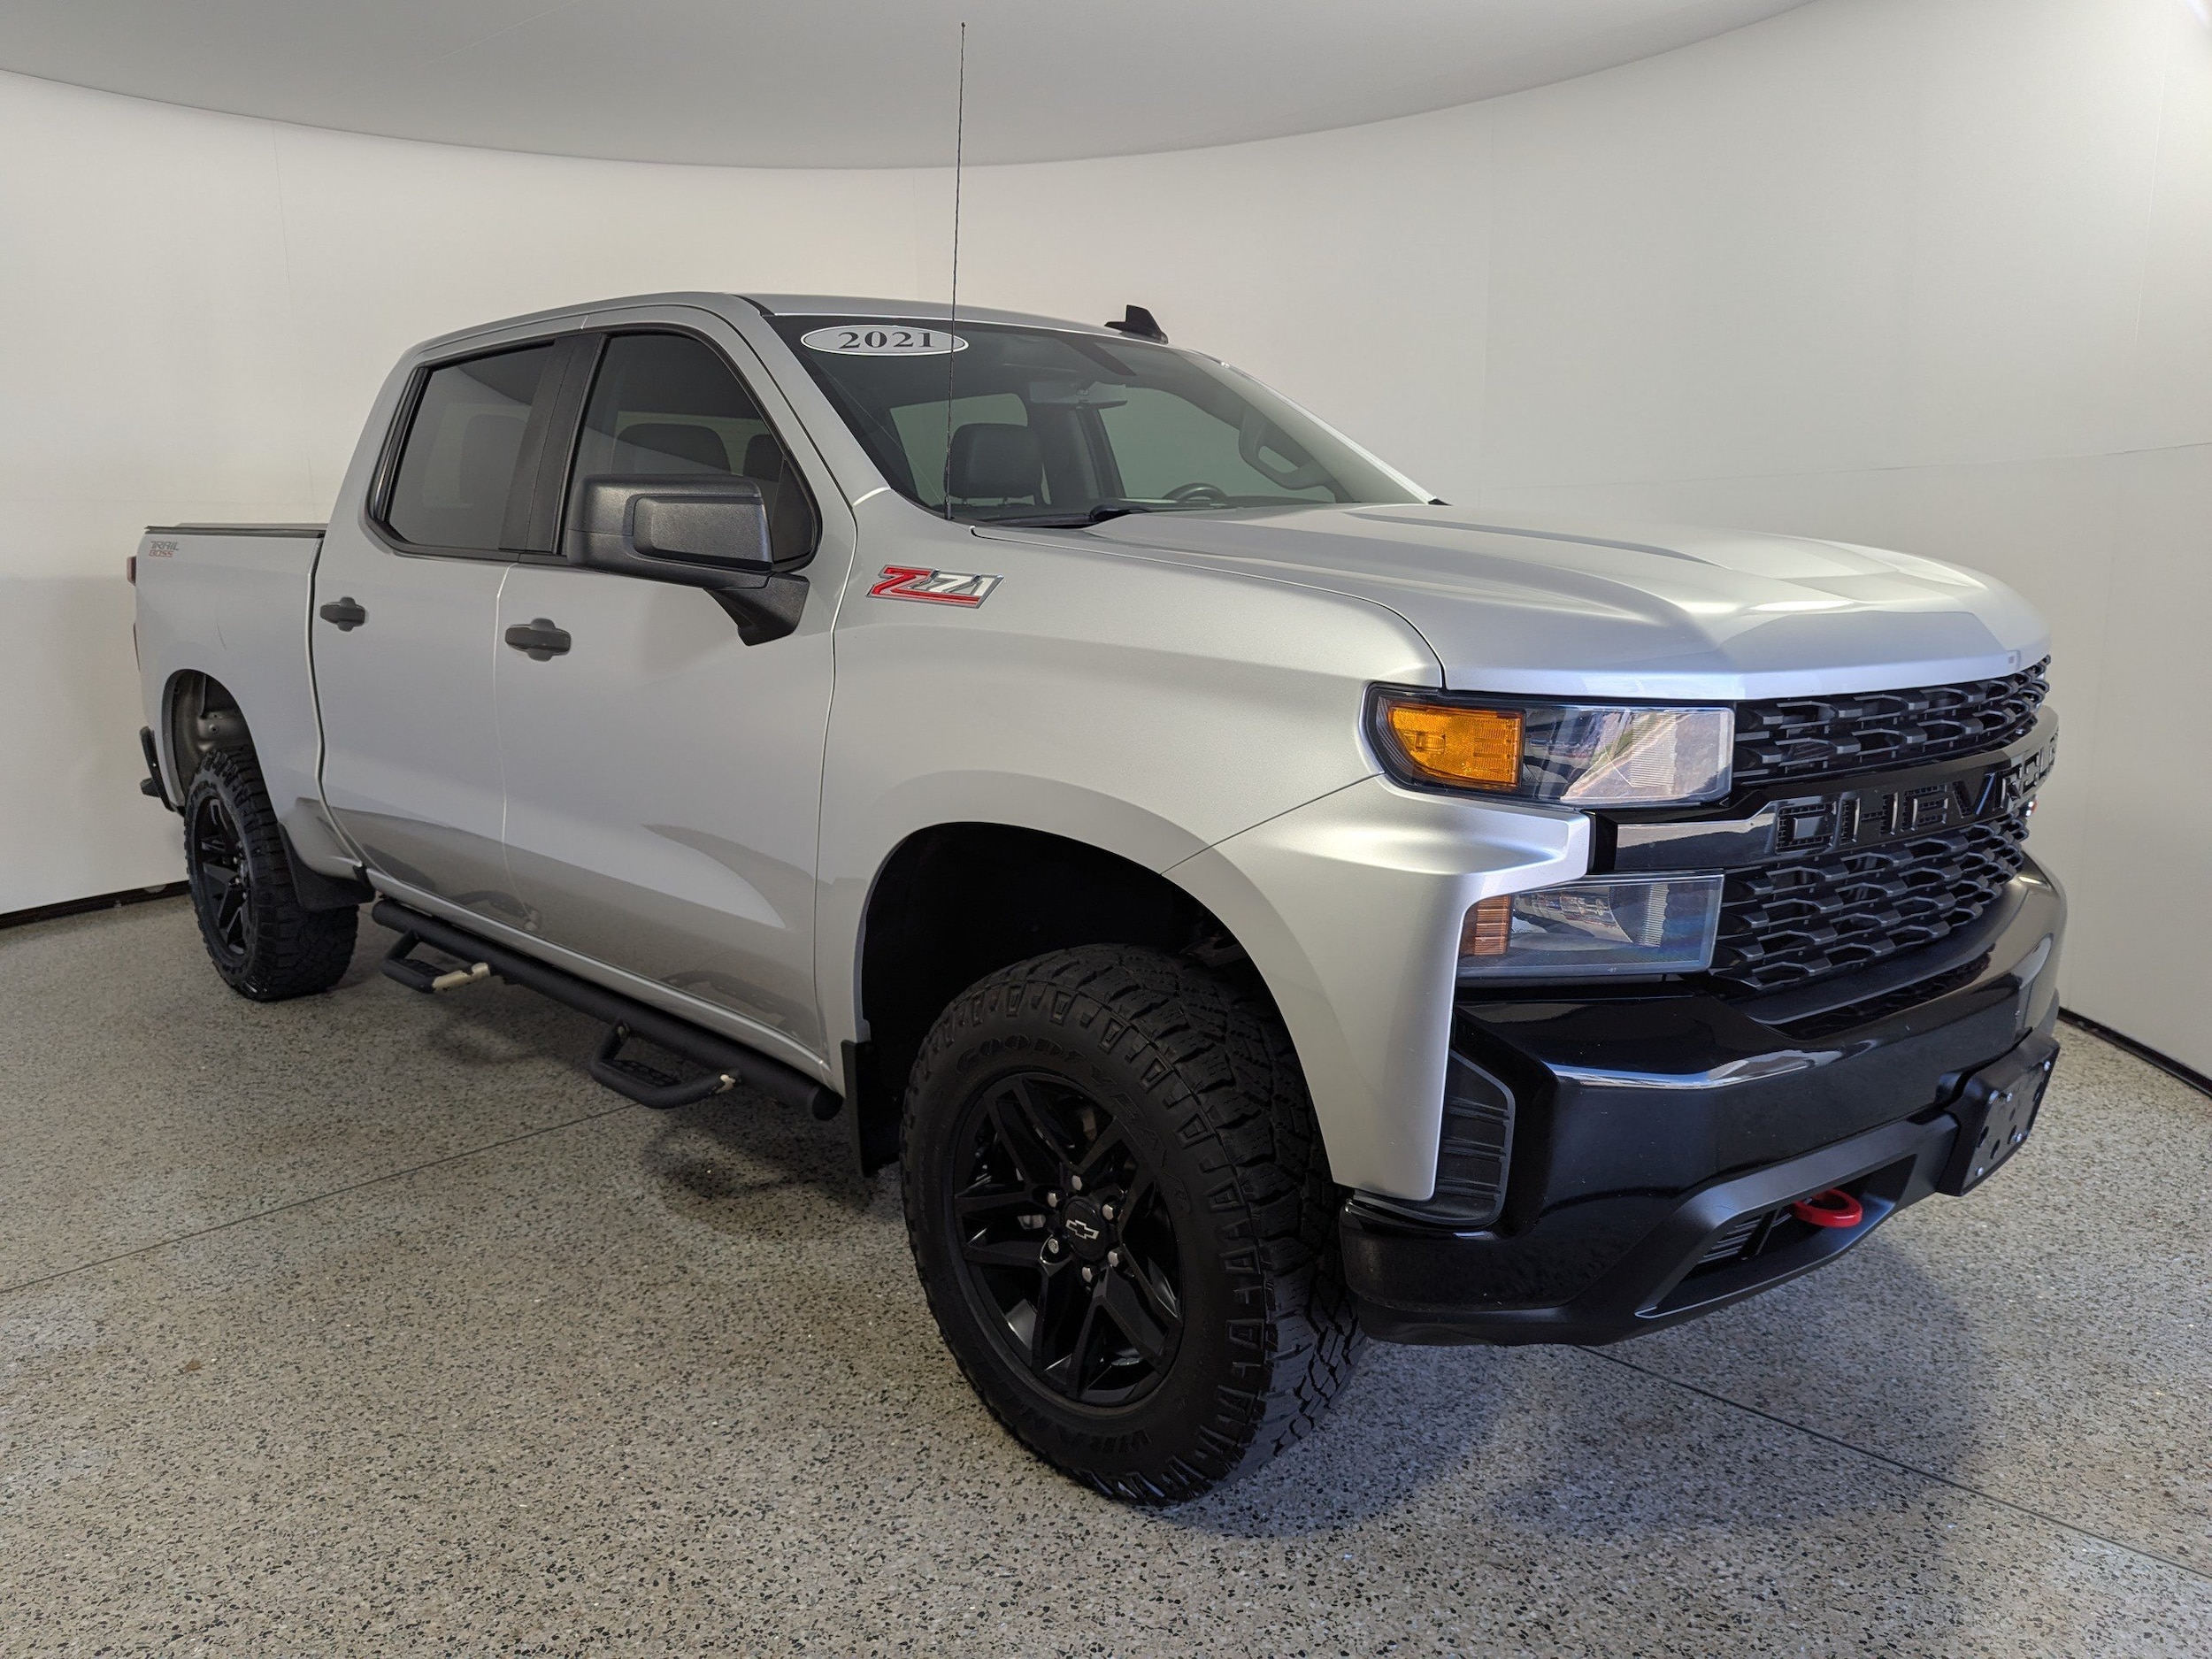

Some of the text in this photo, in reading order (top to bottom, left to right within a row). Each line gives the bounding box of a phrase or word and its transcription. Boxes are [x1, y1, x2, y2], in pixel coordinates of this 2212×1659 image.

[838, 330, 937, 349] 2021
[150, 540, 180, 551] TRAIL
[866, 565, 1005, 609] Z71
[1775, 726, 2059, 855] CHEVROLE
